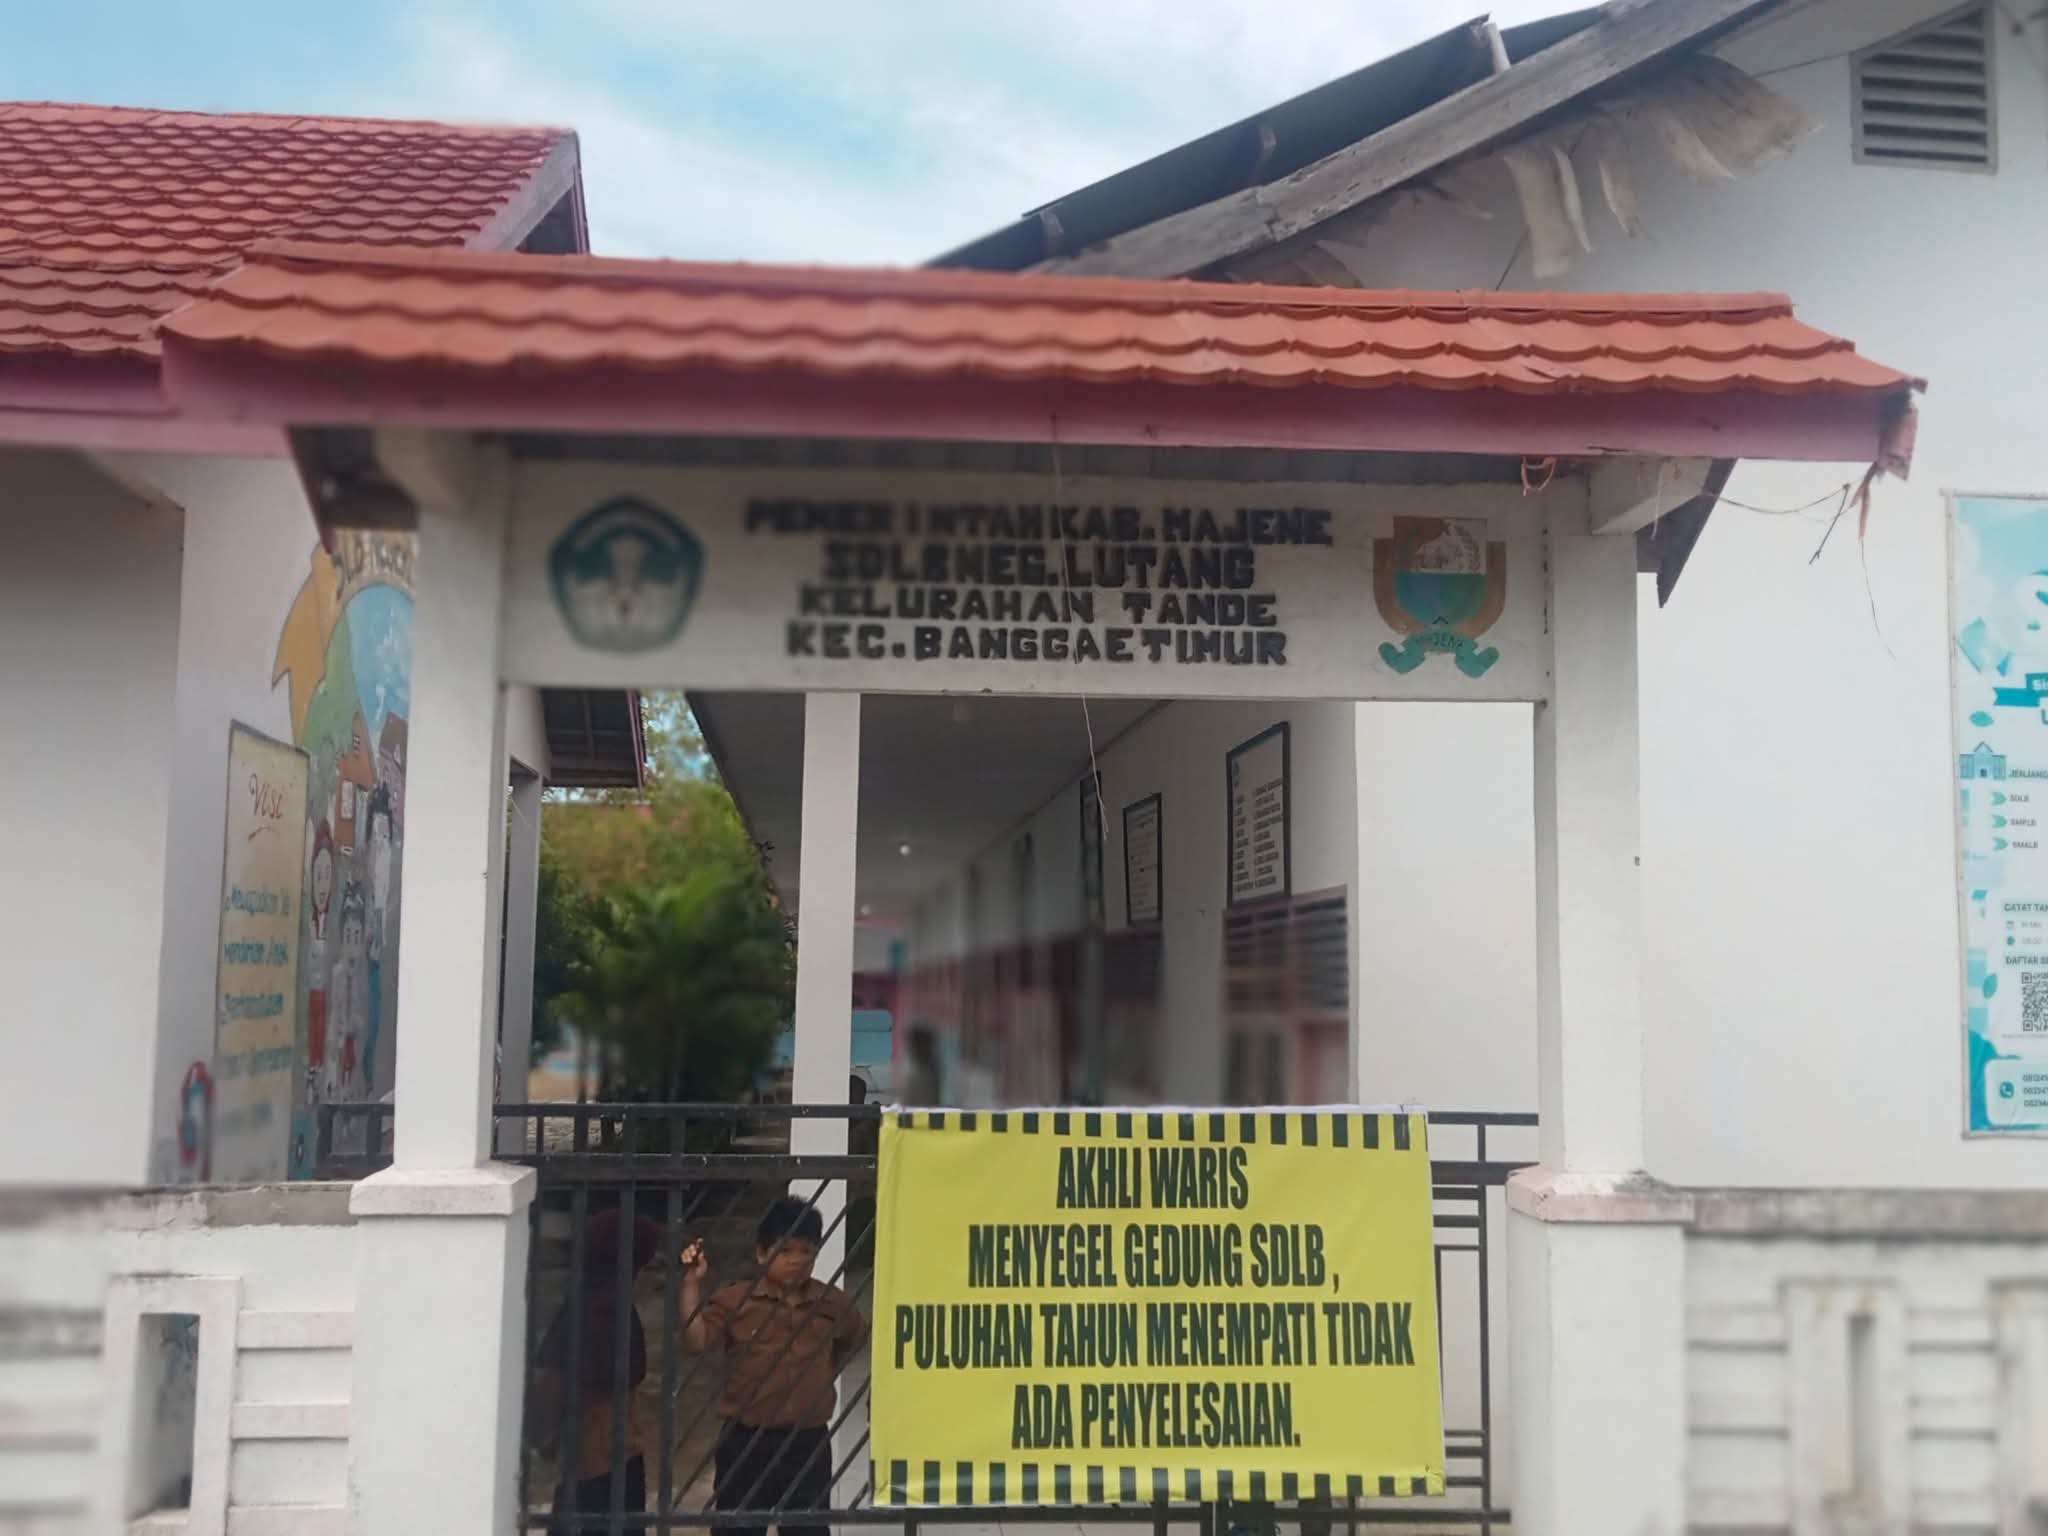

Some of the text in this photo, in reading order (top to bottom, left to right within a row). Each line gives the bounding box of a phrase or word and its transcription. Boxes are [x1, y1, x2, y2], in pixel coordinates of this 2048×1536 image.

[797, 584, 1278, 627] KELURAHAN TANDE
[1056, 1146, 1249, 1208] AKHLI WARIS
[968, 1224, 1117, 1287] MENYEGEL
[1124, 1224, 1243, 1287] GEDUNG
[895, 1302, 1415, 1369] PULUHAN TAHUN MENEMPATI TIDAK
[1011, 1382, 1301, 1449] ADA PENYELESAIAN.
